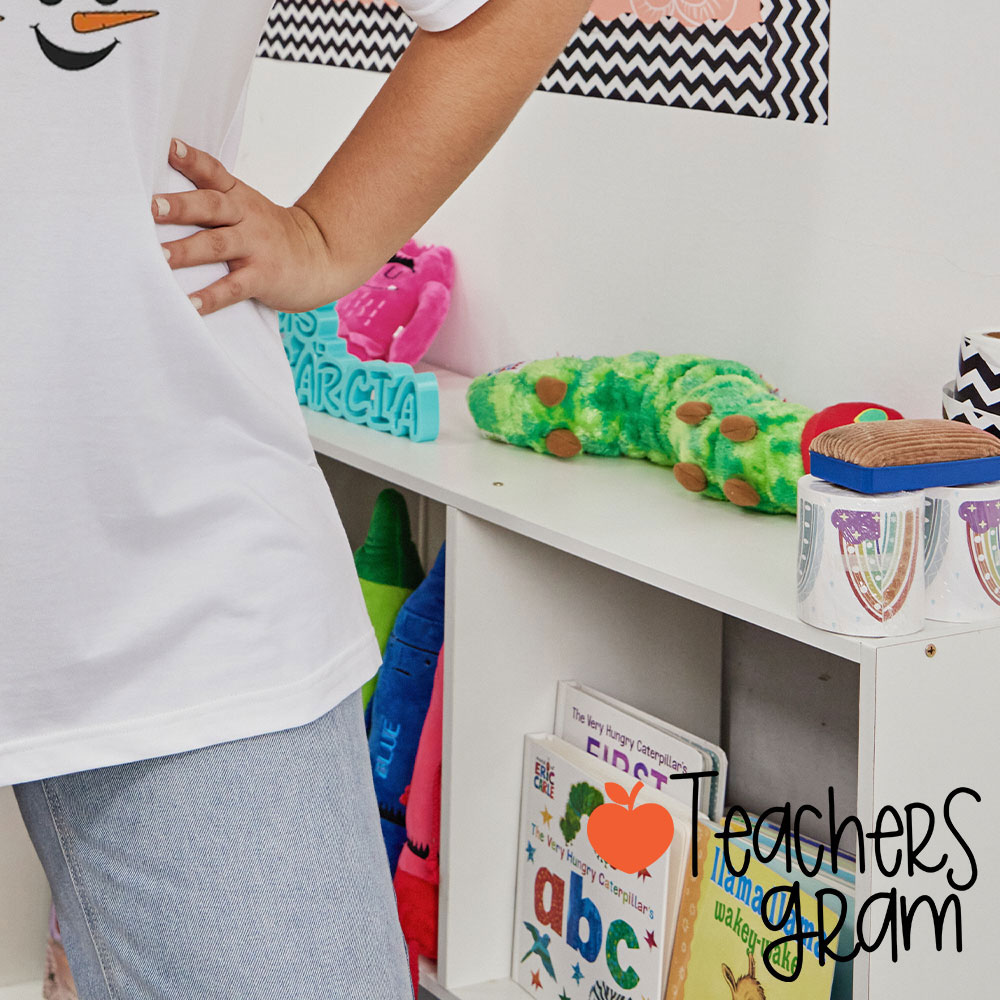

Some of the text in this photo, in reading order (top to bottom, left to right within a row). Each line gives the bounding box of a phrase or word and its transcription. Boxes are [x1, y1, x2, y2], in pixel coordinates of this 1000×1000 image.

[285, 349, 420, 439] ARCIA
[375, 717, 401, 780] BLUE
[534, 761, 556, 786] ERIC
[571, 706, 689, 776] The Very Hungry Caterpillar's
[532, 774, 556, 800] CARLE
[530, 822, 655, 921] The Very Hungry Caterpillar's
[533, 866, 641, 991] abc
